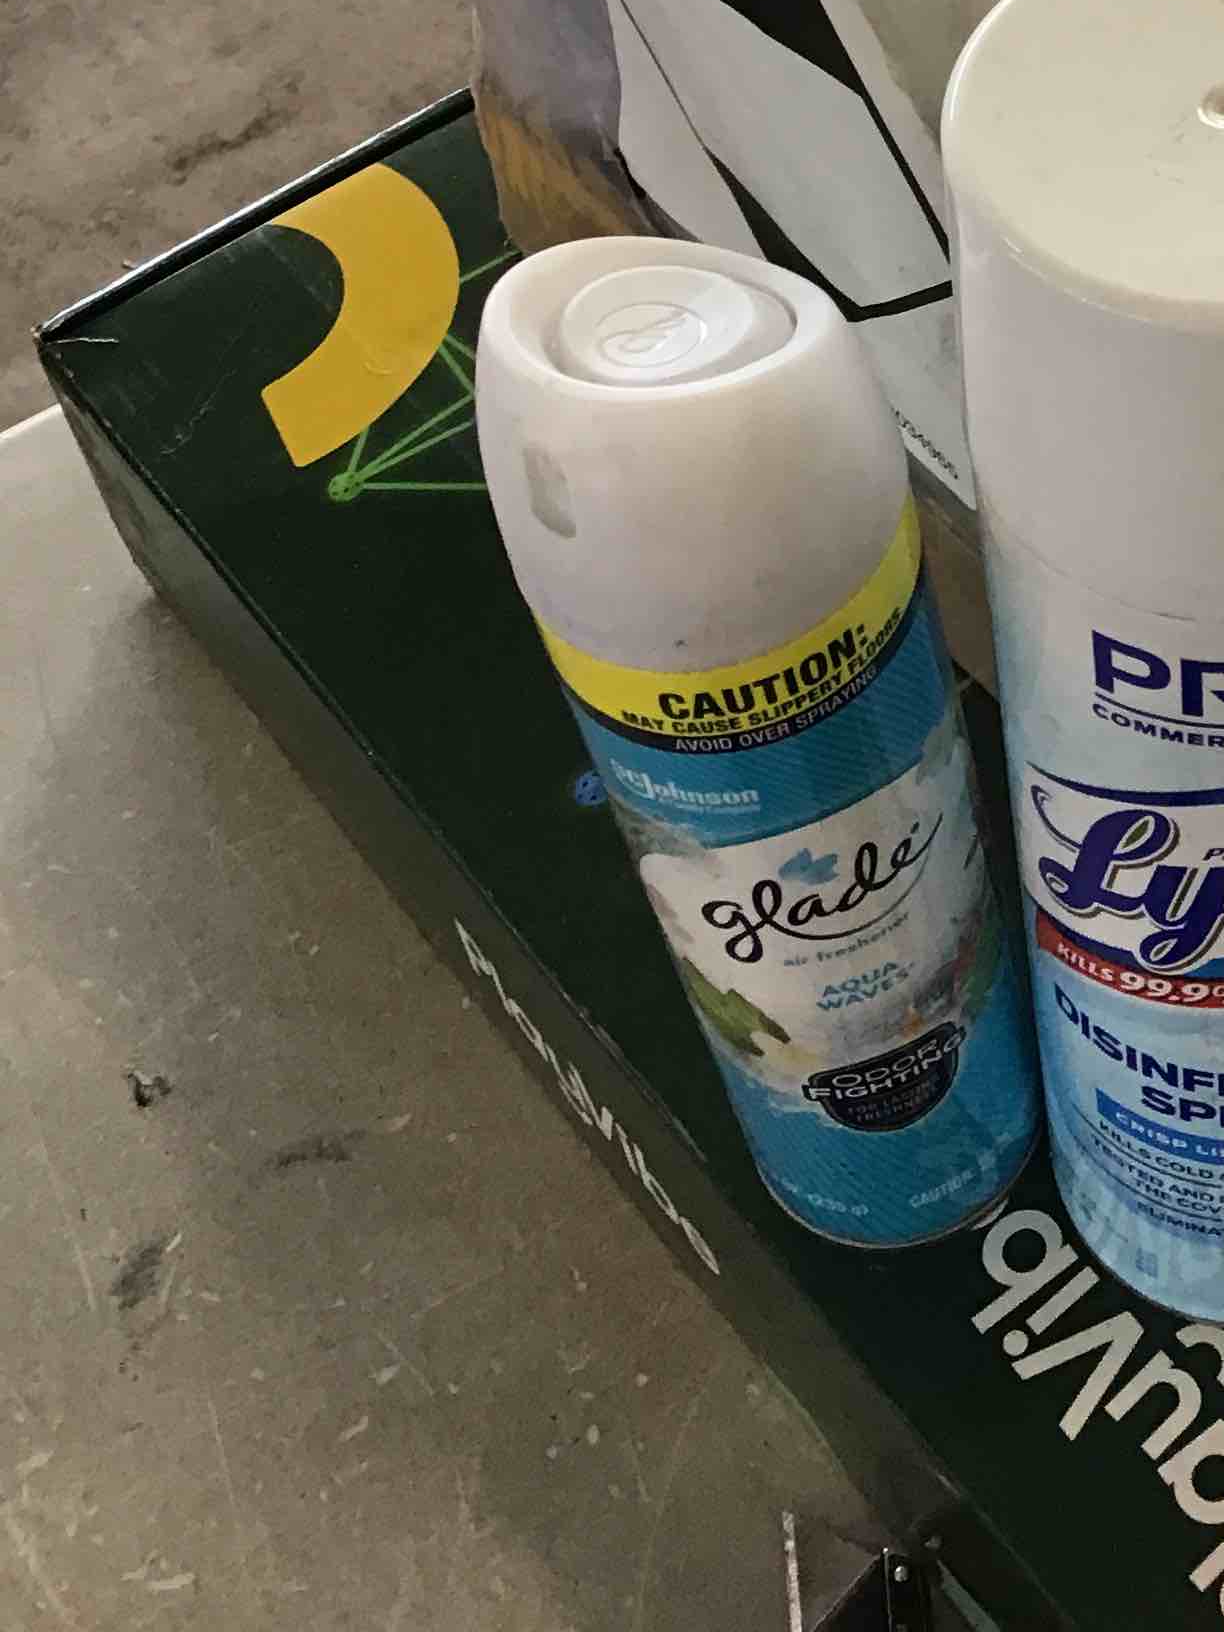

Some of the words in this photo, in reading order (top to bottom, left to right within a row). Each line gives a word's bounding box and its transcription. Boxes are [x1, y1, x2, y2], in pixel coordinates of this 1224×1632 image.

[657, 622, 868, 721] CAUTION:
[620, 709, 665, 732] MAY
[671, 716, 742, 737] CAUSE
[748, 672, 844, 727] SLIPPERY
[674, 736, 734, 754] AVOID
[738, 722, 791, 749] OVER
[794, 664, 879, 730] SPRAYING
[822, 961, 898, 999] AQUA
[1056, 941, 1113, 982] KILLS
[808, 1030, 963, 1101] FIGHTING
[831, 1038, 940, 1089] ODOR
[1099, 1119, 1152, 1160] KILLS
[1155, 1155, 1215, 1180] COLD
[1115, 1111, 1188, 1149] CRISP
[1136, 1179, 1173, 1203] THE
[1168, 1184, 1215, 1202] AND
